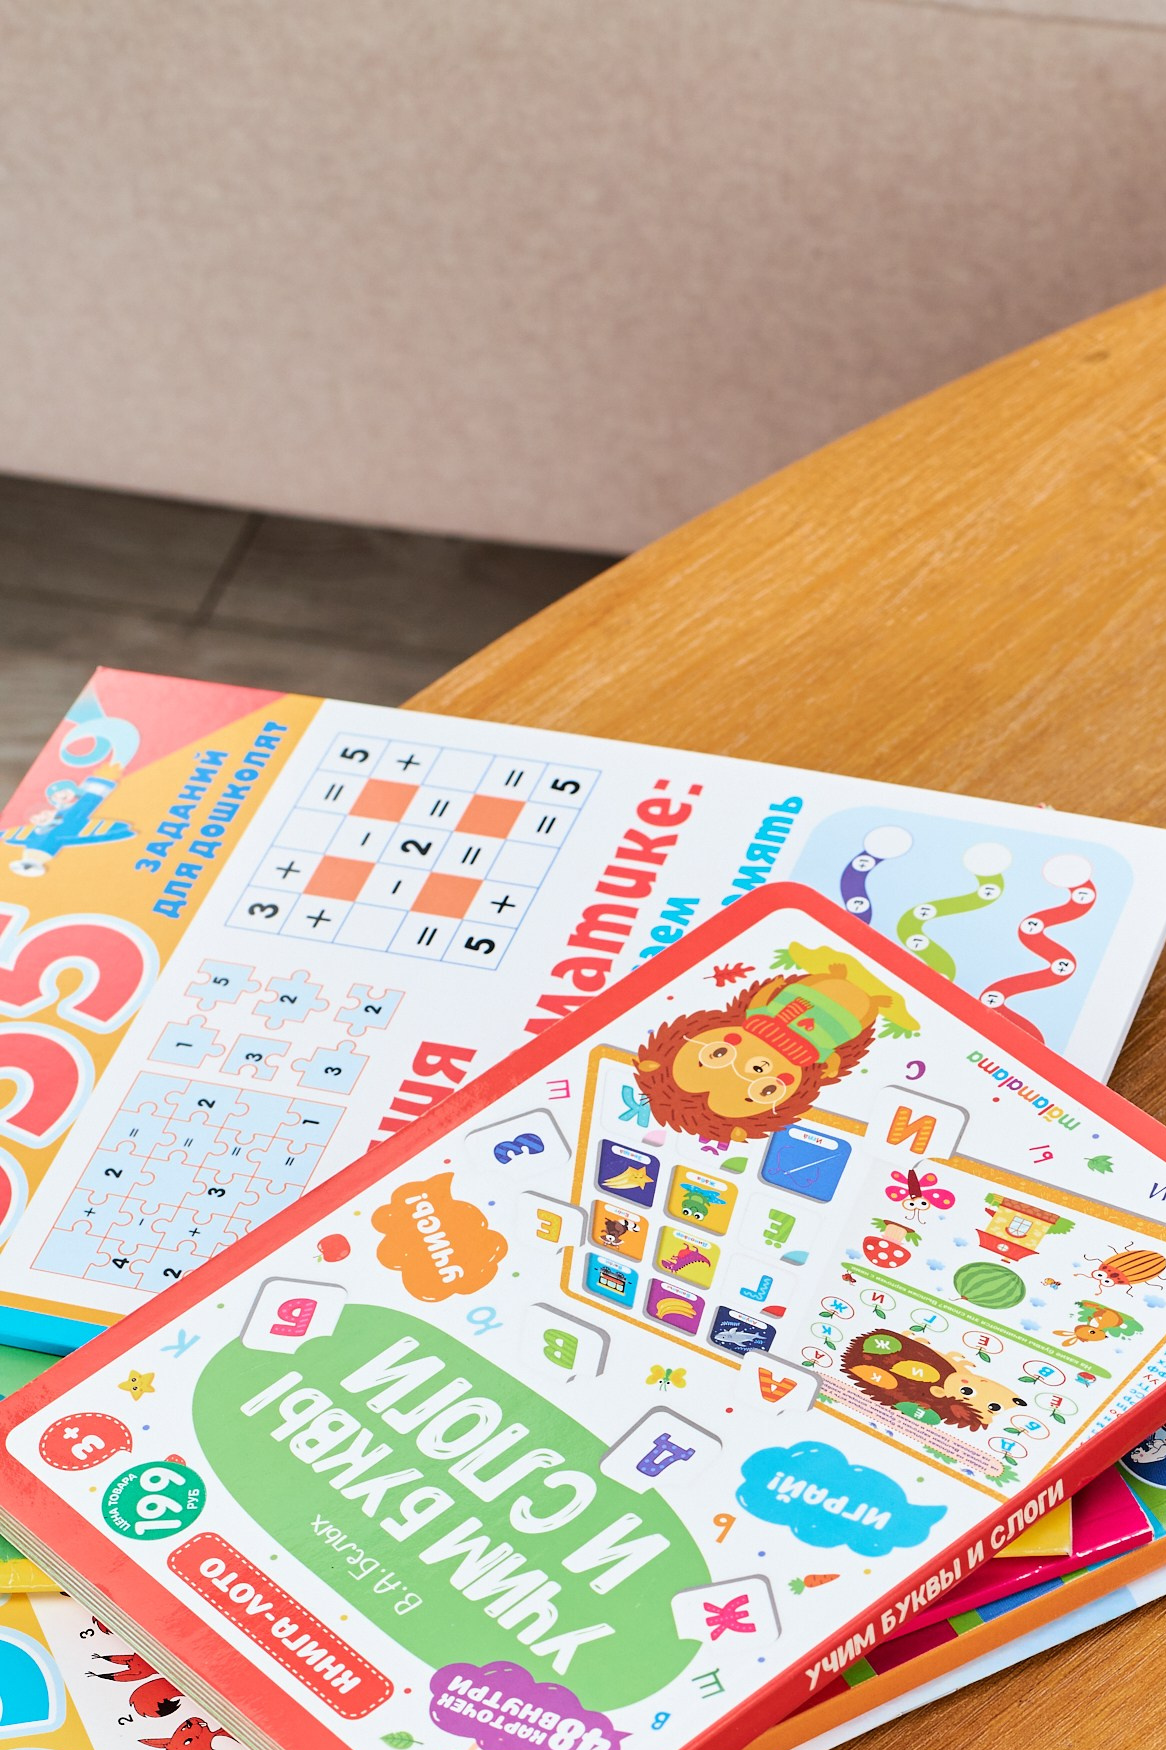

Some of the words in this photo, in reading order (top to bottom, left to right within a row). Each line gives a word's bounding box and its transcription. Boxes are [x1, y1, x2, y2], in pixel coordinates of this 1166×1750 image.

[340, 748, 369, 762] 5
[551, 779, 580, 794] 5
[135, 750, 229, 874] ЗАДАНИЙ
[152, 863, 202, 919] ДЛЯ
[201, 721, 289, 860] ДОШКОЛЯТ
[401, 840, 432, 856] 2
[248, 903, 279, 918] 3
[464, 937, 495, 954] 5
[213, 977, 229, 986] 5
[280, 995, 297, 1004] 2
[364, 1005, 382, 1014] 2
[245, 1053, 262, 1062] 3
[325, 1067, 341, 1076] 3
[198, 1099, 215, 1108] 2
[886, 1106, 937, 1154] И
[105, 1168, 122, 1178] 2
[208, 1188, 225, 1197] 3
[763, 1209, 796, 1248] Ё
[112, 1258, 129, 1269] 4
[163, 1268, 182, 1278] 2
[740, 1275, 773, 1302] Г
[872, 1292, 884, 1303] И
[830, 1300, 847, 1312] Ж
[270, 1298, 317, 1337] Б
[466, 1306, 503, 1335] Ю
[822, 1325, 831, 1335] К
[160, 1329, 200, 1358] К
[875, 1339, 890, 1350] Ж
[978, 1335, 989, 1346] Е
[543, 1329, 578, 1370] В
[815, 1351, 825, 1359] А
[871, 1373, 882, 1382] К
[912, 1368, 923, 1377] И
[1039, 1367, 1055, 1377] В
[758, 1367, 797, 1403] А
[1051, 1396, 1062, 1408] Ё
[914, 1408, 925, 1419] Ё
[1026, 1421, 1041, 1430] Б
[340, 1335, 598, 1534] СЛОГИ
[63, 1425, 106, 1461] 3+
[1001, 1439, 1015, 1451] Д
[240, 1370, 455, 1543] БУКВЫ
[636, 1433, 696, 1477] Д
[108, 1472, 138, 1507] ТОВАРА
[135, 1466, 187, 1536] 199
[186, 1487, 201, 1510] РУБ
[766, 1471, 893, 1532] ИГРАЙ!
[109, 1510, 131, 1532] ЦЕНА
[561, 1512, 671, 1595] И
[805, 1626, 877, 1690] УЧИМ
[880, 1566, 963, 1634] БУКВЫ
[966, 1543, 985, 1575] И
[989, 1478, 1065, 1550] СЛОГИ
[418, 1516, 615, 1675] УЧИМ
[703, 1594, 756, 1641] Ж
[199, 1556, 362, 1696] КНИГА-ЛОТО
[80, 1629, 94, 1639] 3
[447, 1675, 559, 1731] ВНУТРИ
[118, 1714, 133, 1725] 2
[437, 1692, 547, 1746] КАРТОЧЕК
